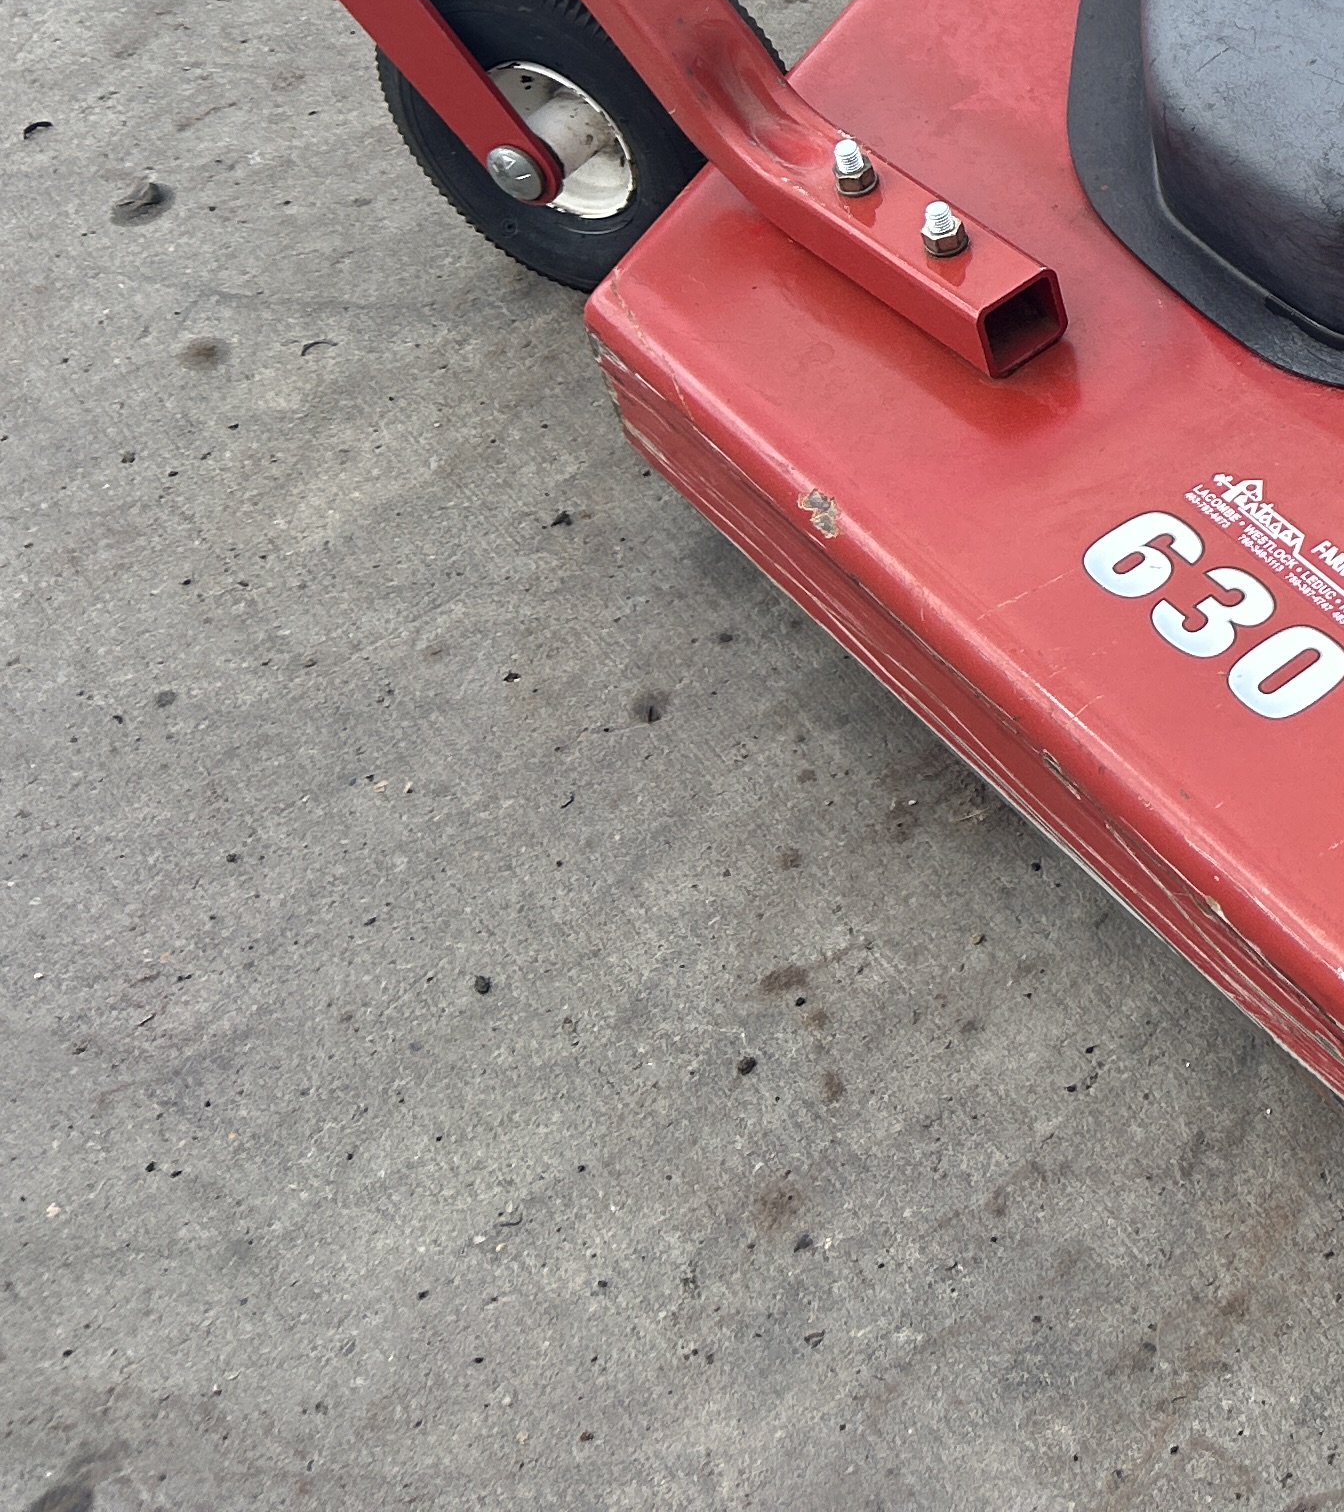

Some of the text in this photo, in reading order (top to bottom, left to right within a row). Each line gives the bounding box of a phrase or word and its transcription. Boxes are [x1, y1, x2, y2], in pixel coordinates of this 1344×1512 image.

[1192, 483, 1241, 523] LACOMBE
[1243, 523, 1299, 569] WESTLOCK
[1299, 570, 1337, 601] LEDUC
